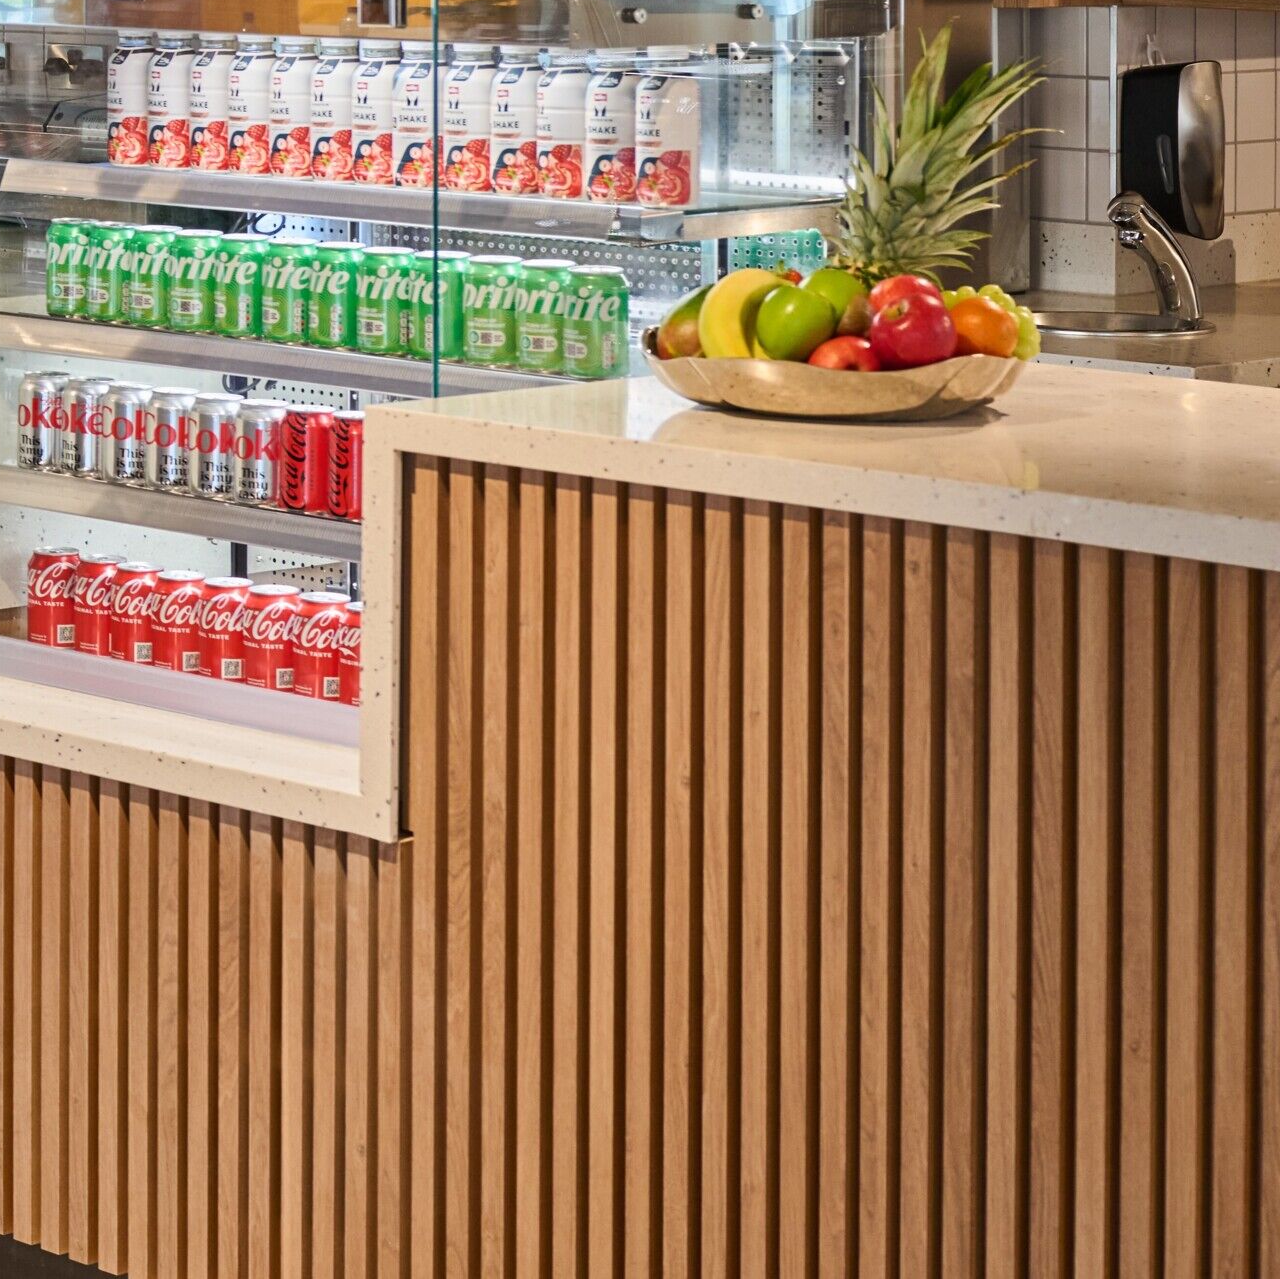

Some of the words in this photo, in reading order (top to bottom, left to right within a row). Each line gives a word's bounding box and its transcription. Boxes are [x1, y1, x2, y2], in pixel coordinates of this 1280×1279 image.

[353, 112, 376, 121] HAKE
[399, 115, 427, 123] SHAKE
[21, 435, 40, 446] This
[204, 461, 229, 472] This
[211, 473, 232, 484] my
[242, 468, 265, 479] This
[200, 482, 231, 493] taste
[208, 633, 229, 641] TASTE
